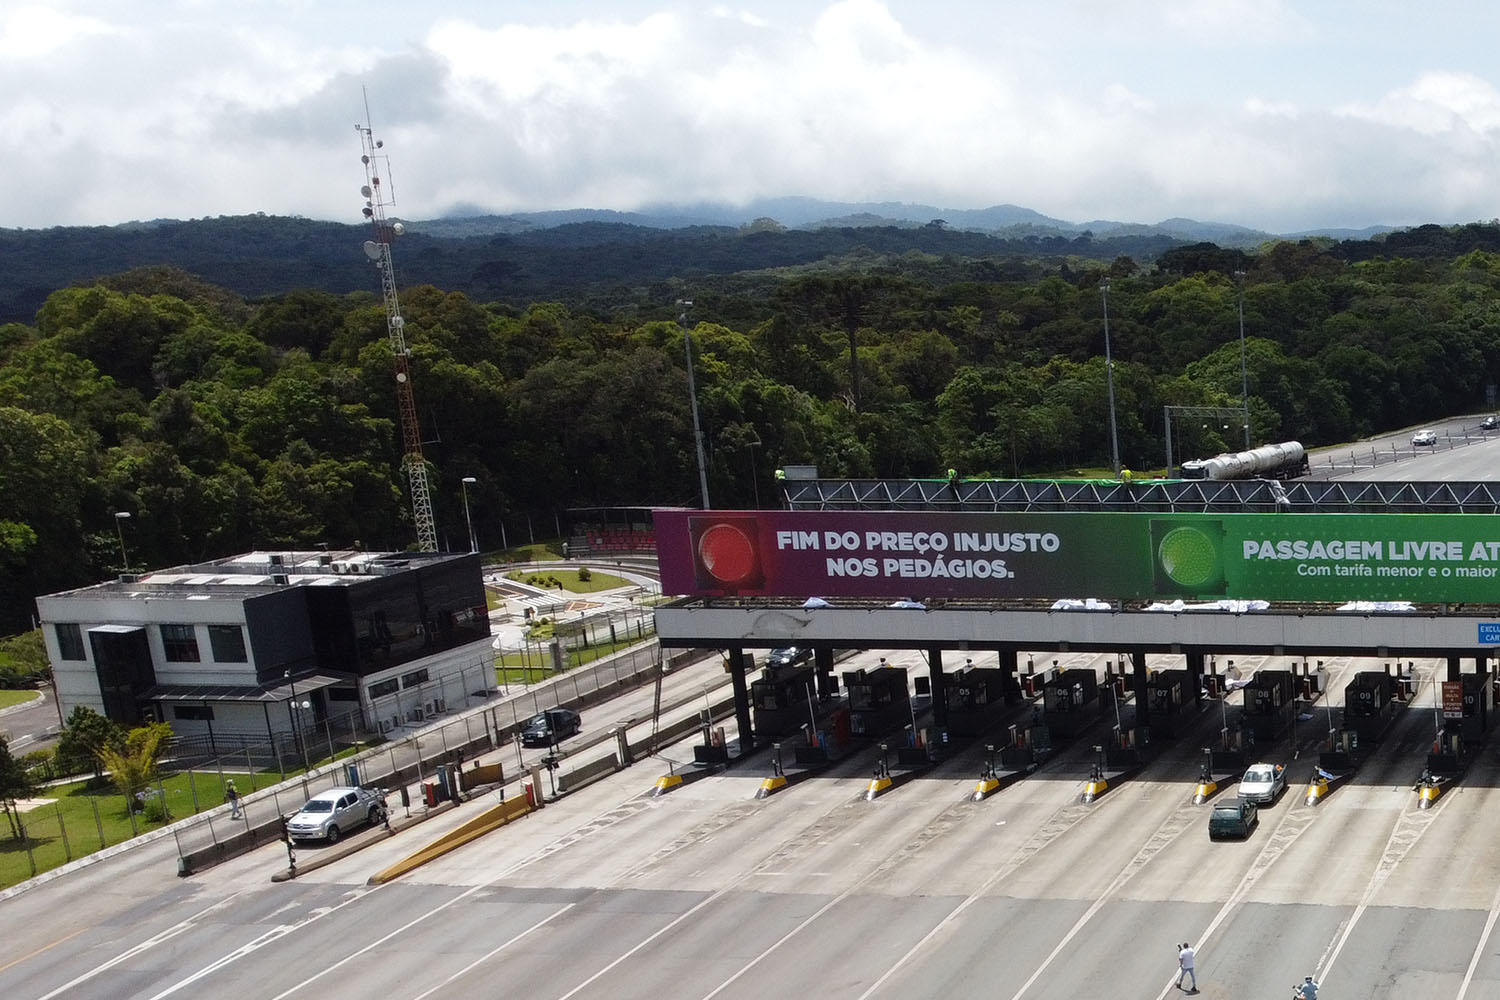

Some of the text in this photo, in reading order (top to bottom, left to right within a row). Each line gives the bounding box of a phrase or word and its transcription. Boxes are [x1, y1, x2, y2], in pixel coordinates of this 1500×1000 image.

[776, 531, 1060, 554] FIM DO PREÇO INJUSTO
[1243, 540, 1382, 560] PASSAGEM
[1389, 540, 1464, 561] LIVRE
[826, 553, 1015, 579] NOS PEDÁGIOS.
[1297, 563, 1331, 576] Com
[1334, 564, 1373, 576] tarifa
[1377, 566, 1424, 577] menor
[1428, 567, 1437, 577] e
[1441, 567, 1451, 577] o
[1455, 564, 1498, 578] maior
[959, 688, 970, 696] 05
[1057, 688, 1069, 696] 06
[1156, 689, 1168, 697] 07
[1359, 692, 1371, 700] 09
[1463, 695, 1474, 704] 10
